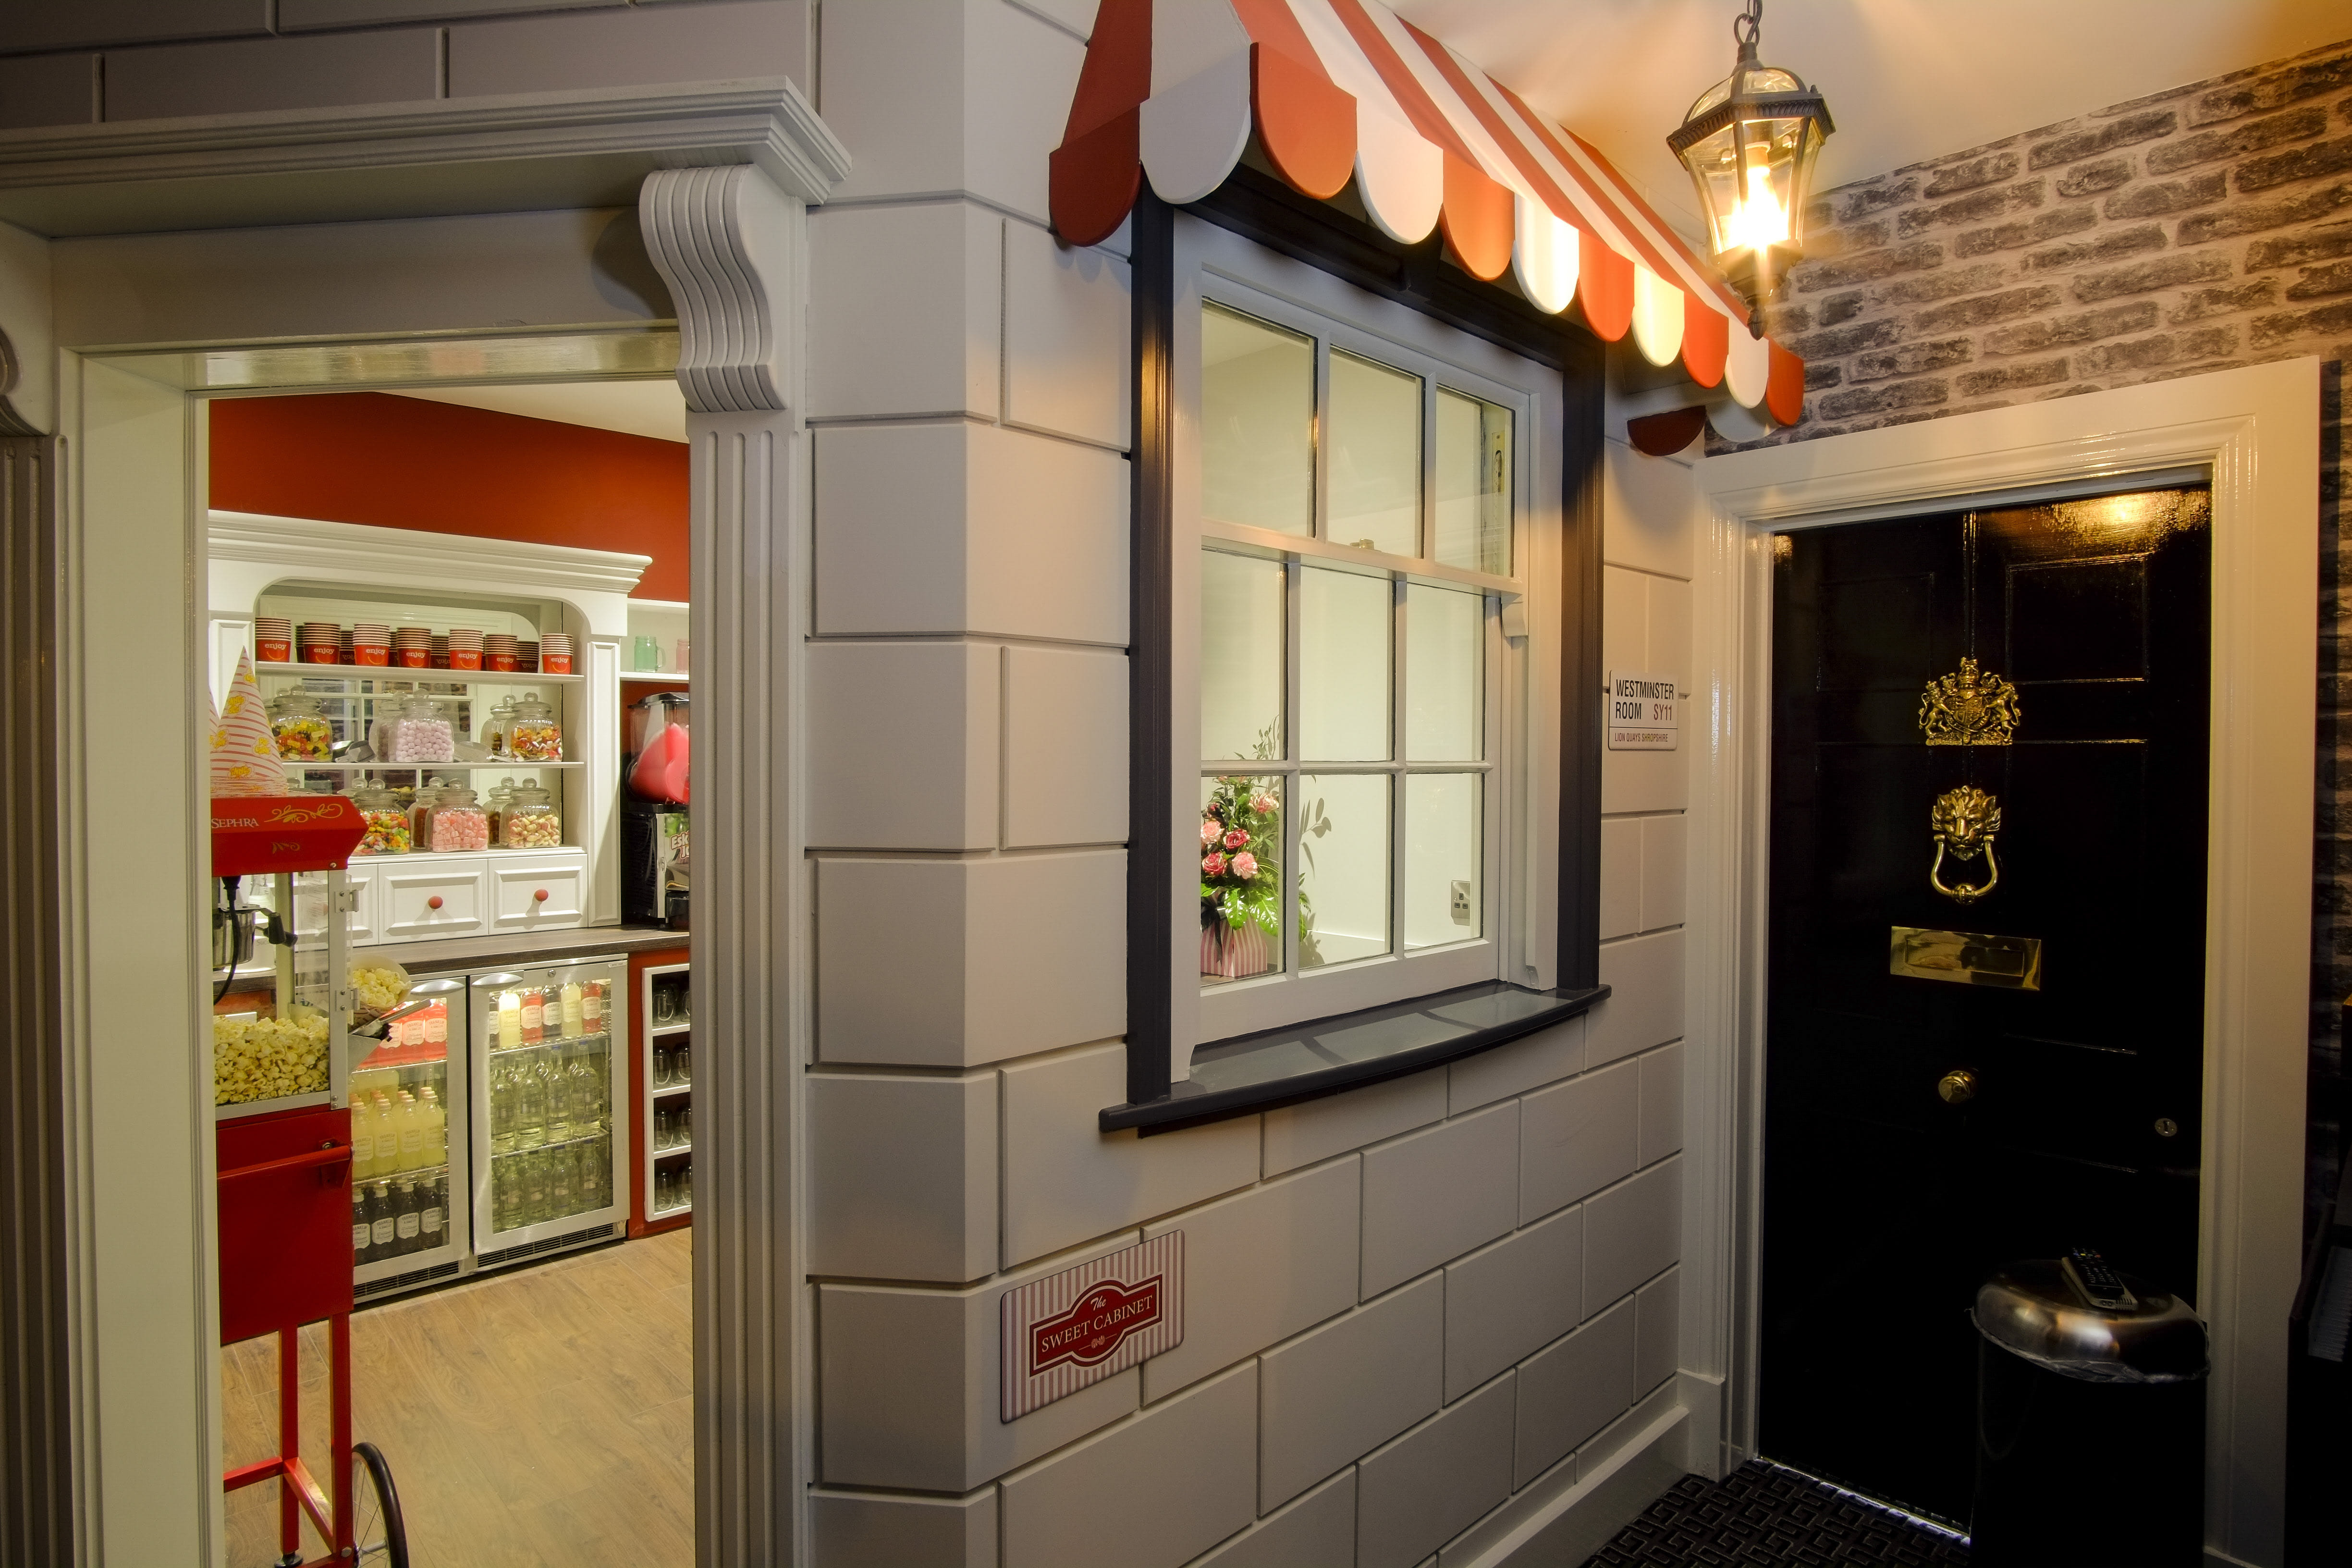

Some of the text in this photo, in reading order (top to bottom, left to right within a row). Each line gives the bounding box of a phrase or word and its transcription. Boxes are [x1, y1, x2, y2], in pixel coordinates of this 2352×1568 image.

[1616, 679, 1674, 700] WESTMINSTER
[1616, 701, 1672, 721] ROOM SY11
[1615, 733, 1668, 742] LION QUAYS SHROPSHIRE
[211, 818, 259, 829] SEPHRA
[1090, 1295, 1106, 1311] The
[1041, 1295, 1153, 1353] SWEET CABINET
